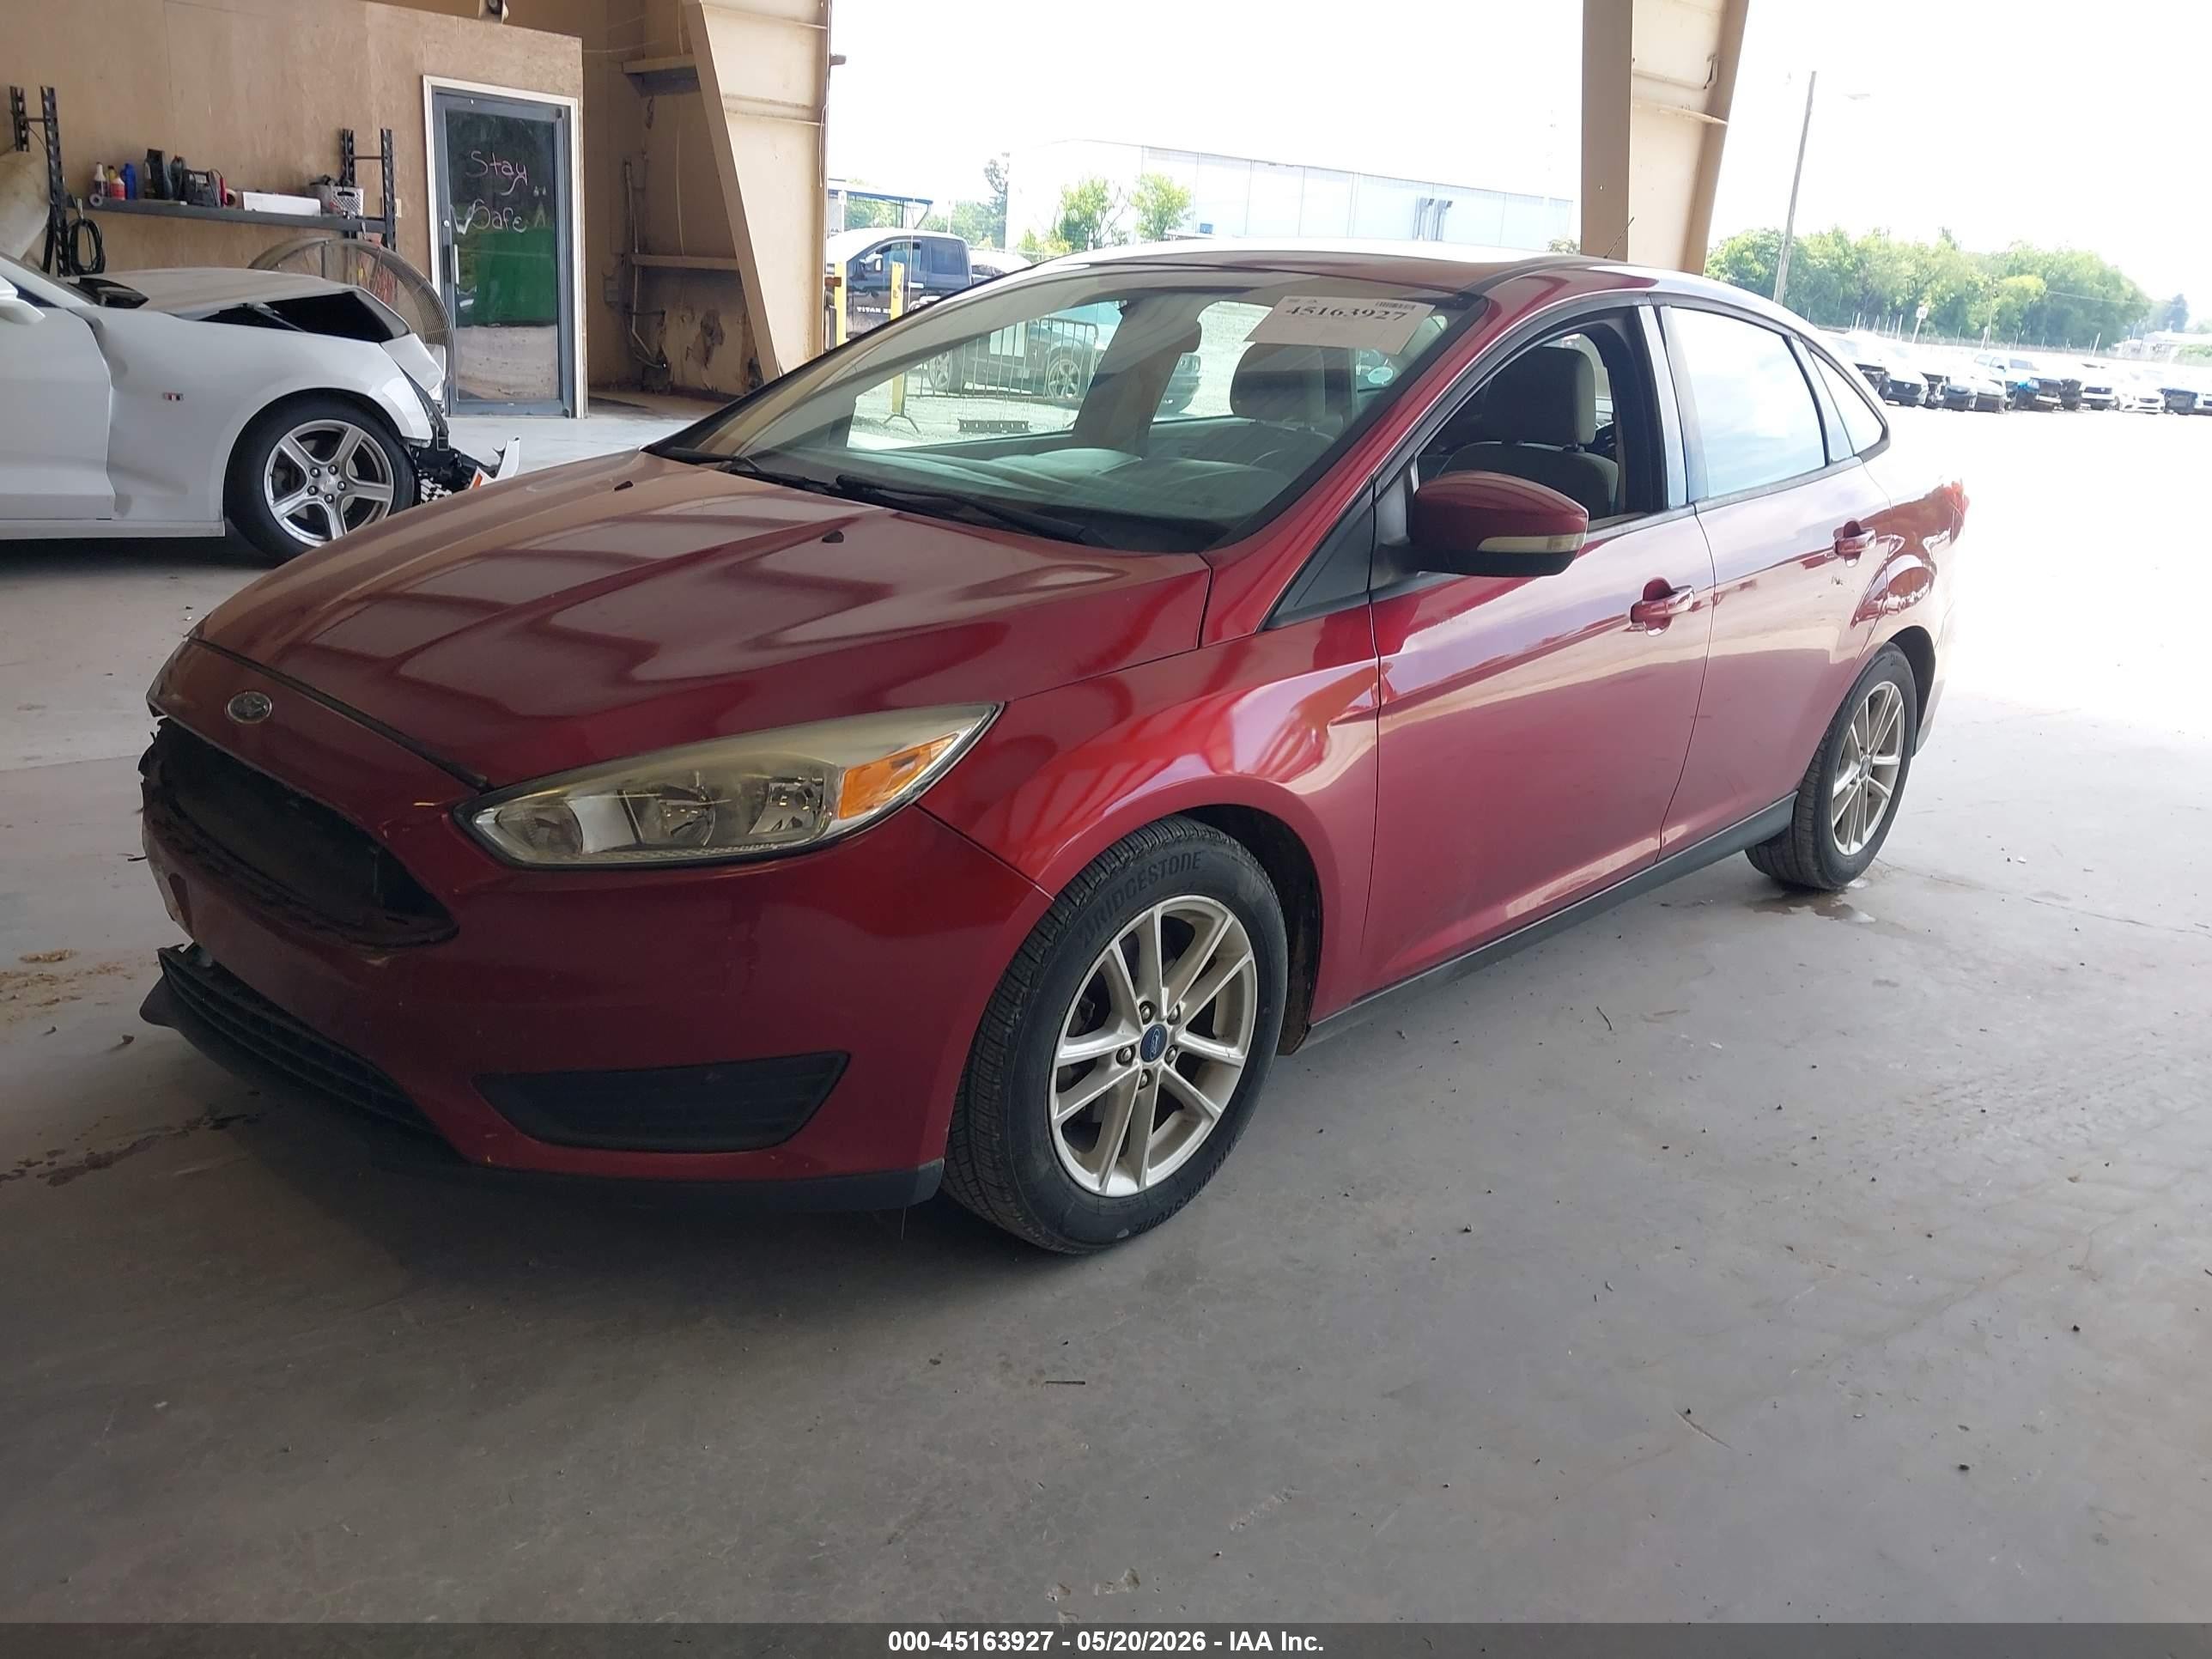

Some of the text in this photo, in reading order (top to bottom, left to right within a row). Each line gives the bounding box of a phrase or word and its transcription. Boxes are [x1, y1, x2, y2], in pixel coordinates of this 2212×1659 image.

[465, 150, 528, 196] Stay
[471, 198, 527, 233] Safe
[1285, 306, 1407, 321] 45163927
